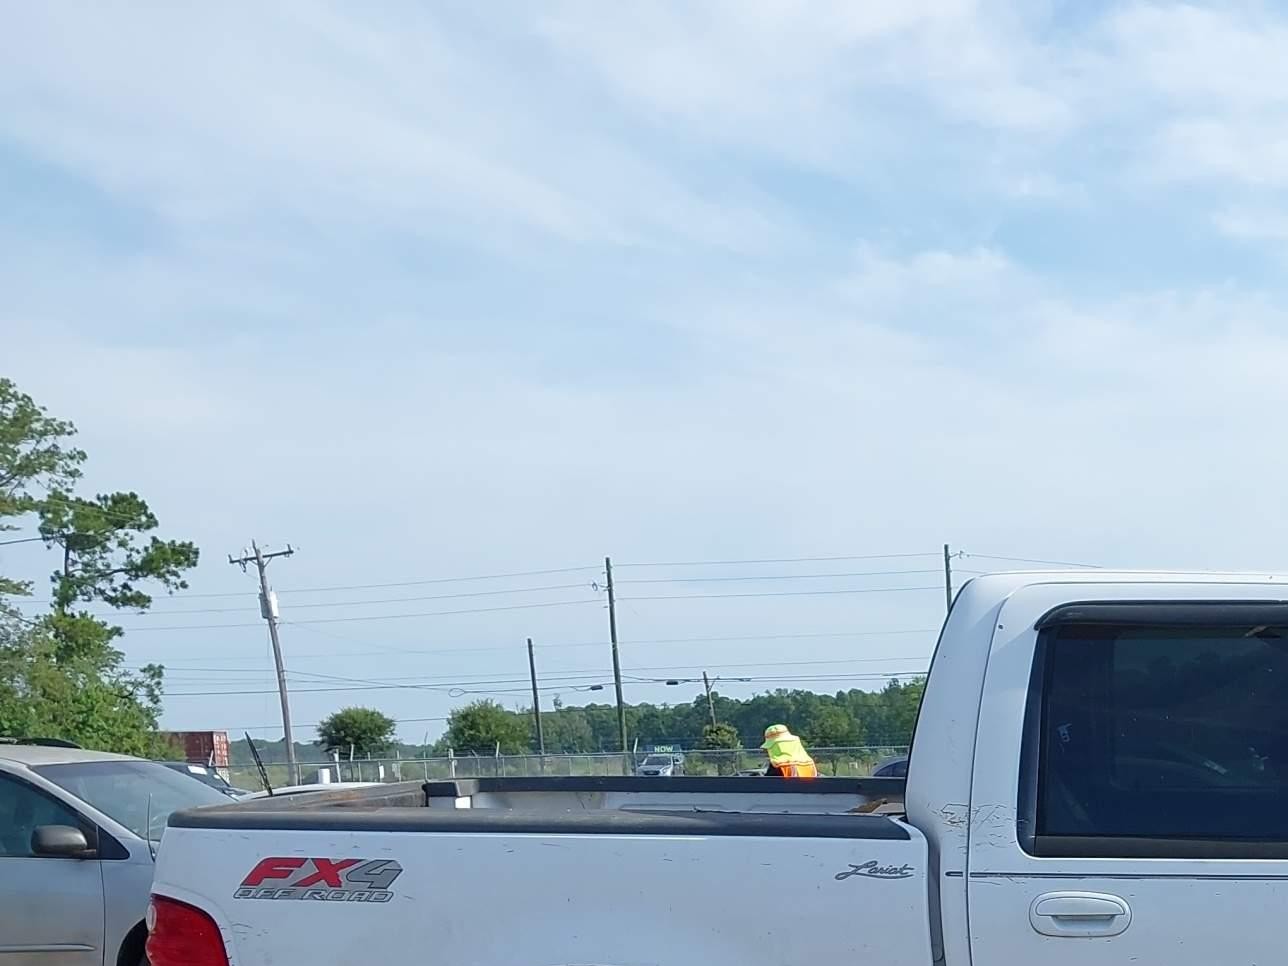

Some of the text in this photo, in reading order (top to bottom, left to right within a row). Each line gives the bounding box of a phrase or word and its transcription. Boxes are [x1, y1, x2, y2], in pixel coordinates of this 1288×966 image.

[654, 745, 673, 753] NOW
[240, 857, 403, 889] FX4
[835, 860, 915, 881] Lariat
[233, 888, 394, 903] OFF ROAD
